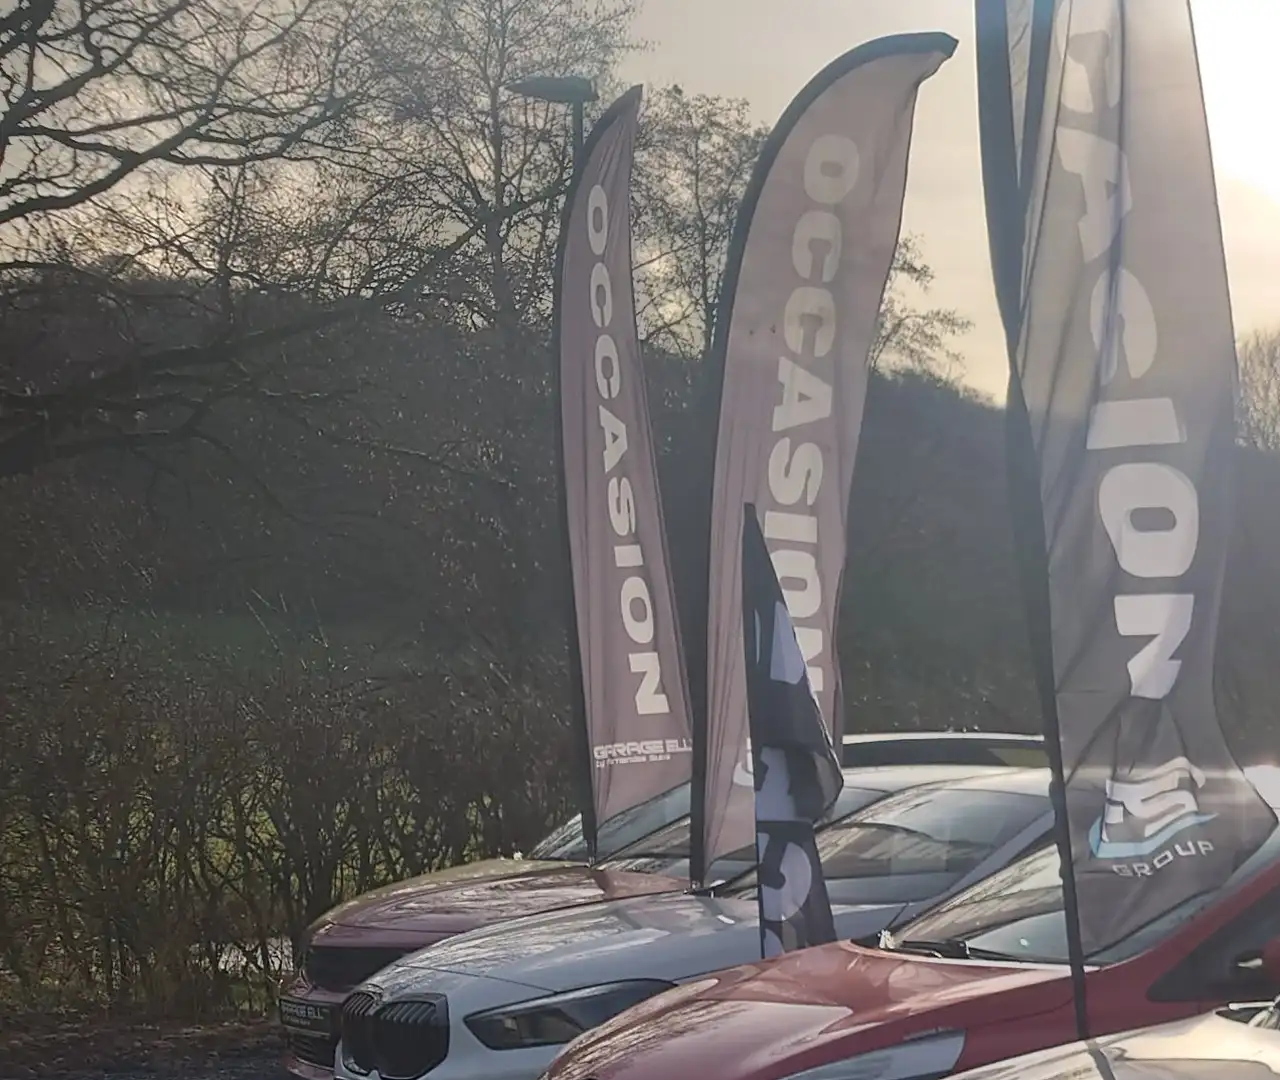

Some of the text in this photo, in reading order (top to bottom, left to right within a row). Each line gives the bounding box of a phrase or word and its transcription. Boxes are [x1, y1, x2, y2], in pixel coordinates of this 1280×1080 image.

[586, 184, 670, 716] OCCASION
[593, 739, 664, 760] GARAGE
[1112, 840, 1215, 878] GROUP
